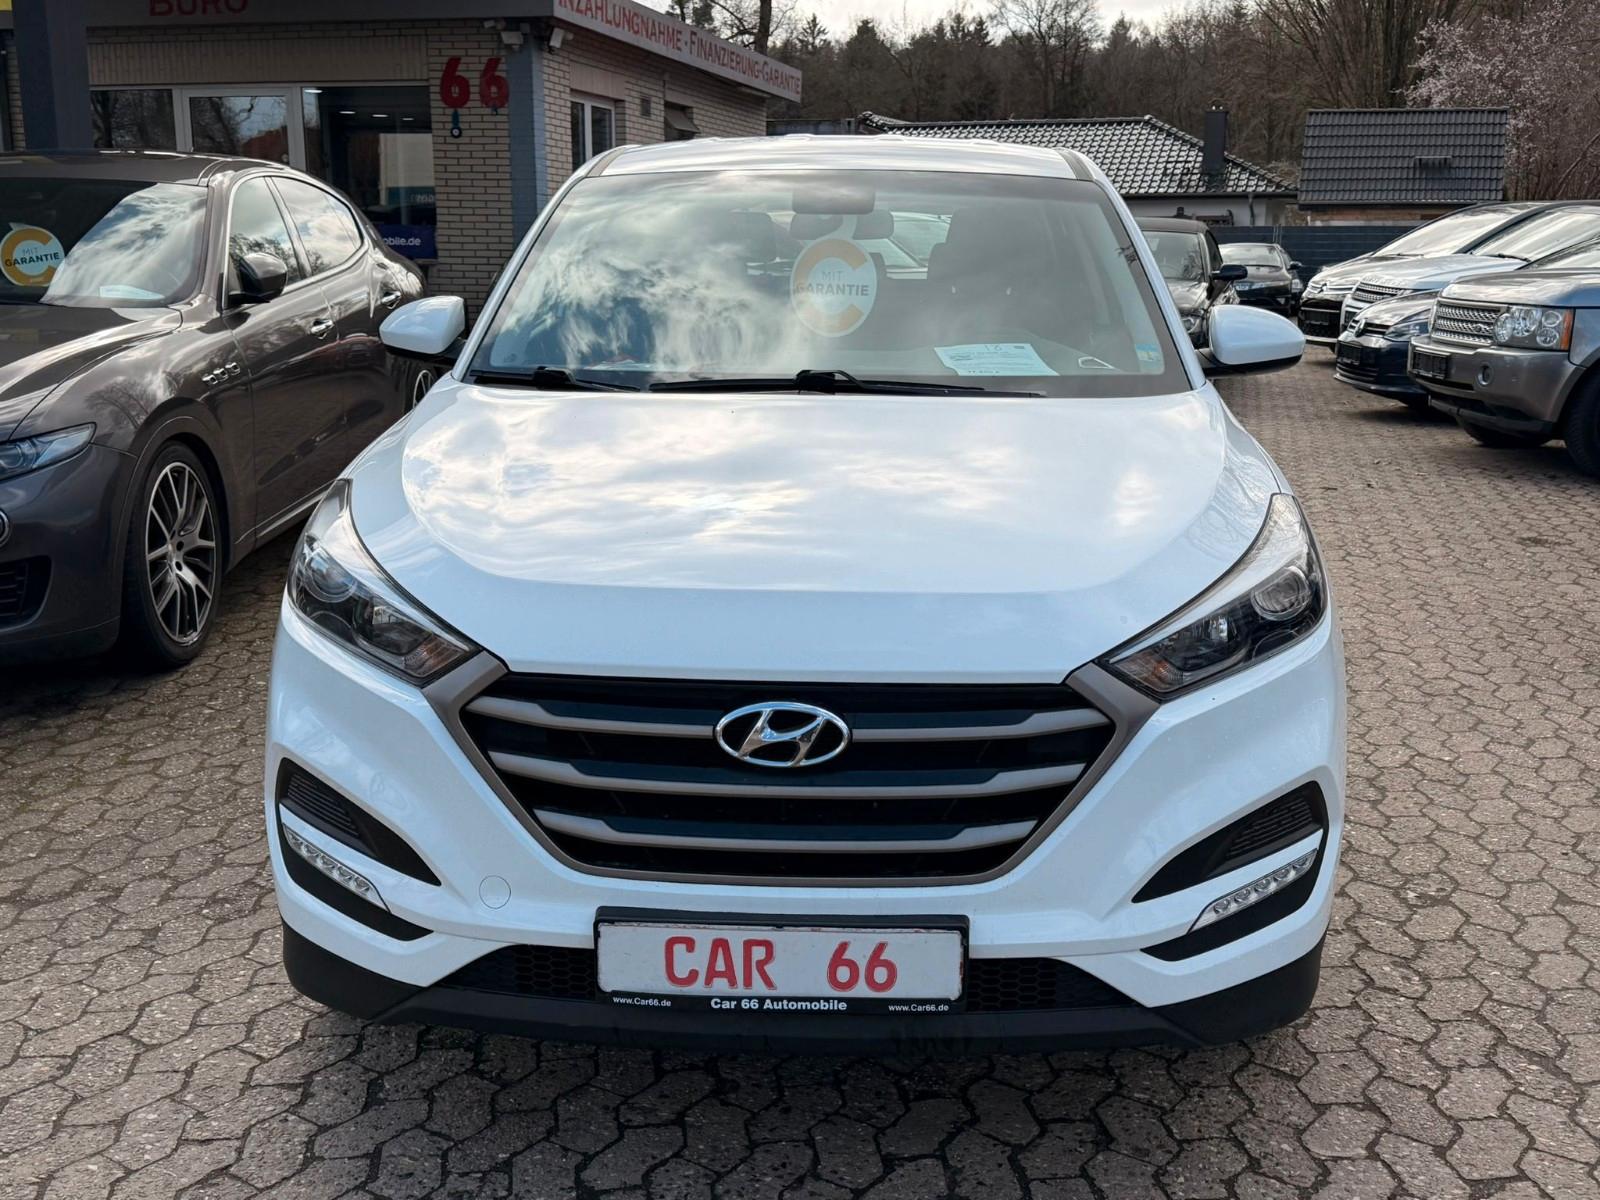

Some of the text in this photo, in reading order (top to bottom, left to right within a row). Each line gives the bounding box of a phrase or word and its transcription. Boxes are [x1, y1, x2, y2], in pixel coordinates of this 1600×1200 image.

[383, 237, 421, 246] obile.de
[5, 252, 60, 267] GARANTIE
[822, 271, 843, 281] MIT
[794, 283, 869, 296] GARANTIE
[664, 935, 898, 993] CAR 66
[612, 995, 672, 1007] www.Car66.de
[710, 998, 847, 1010] Car 66 Automobile
[888, 1003, 949, 1012] www.Car66.de
